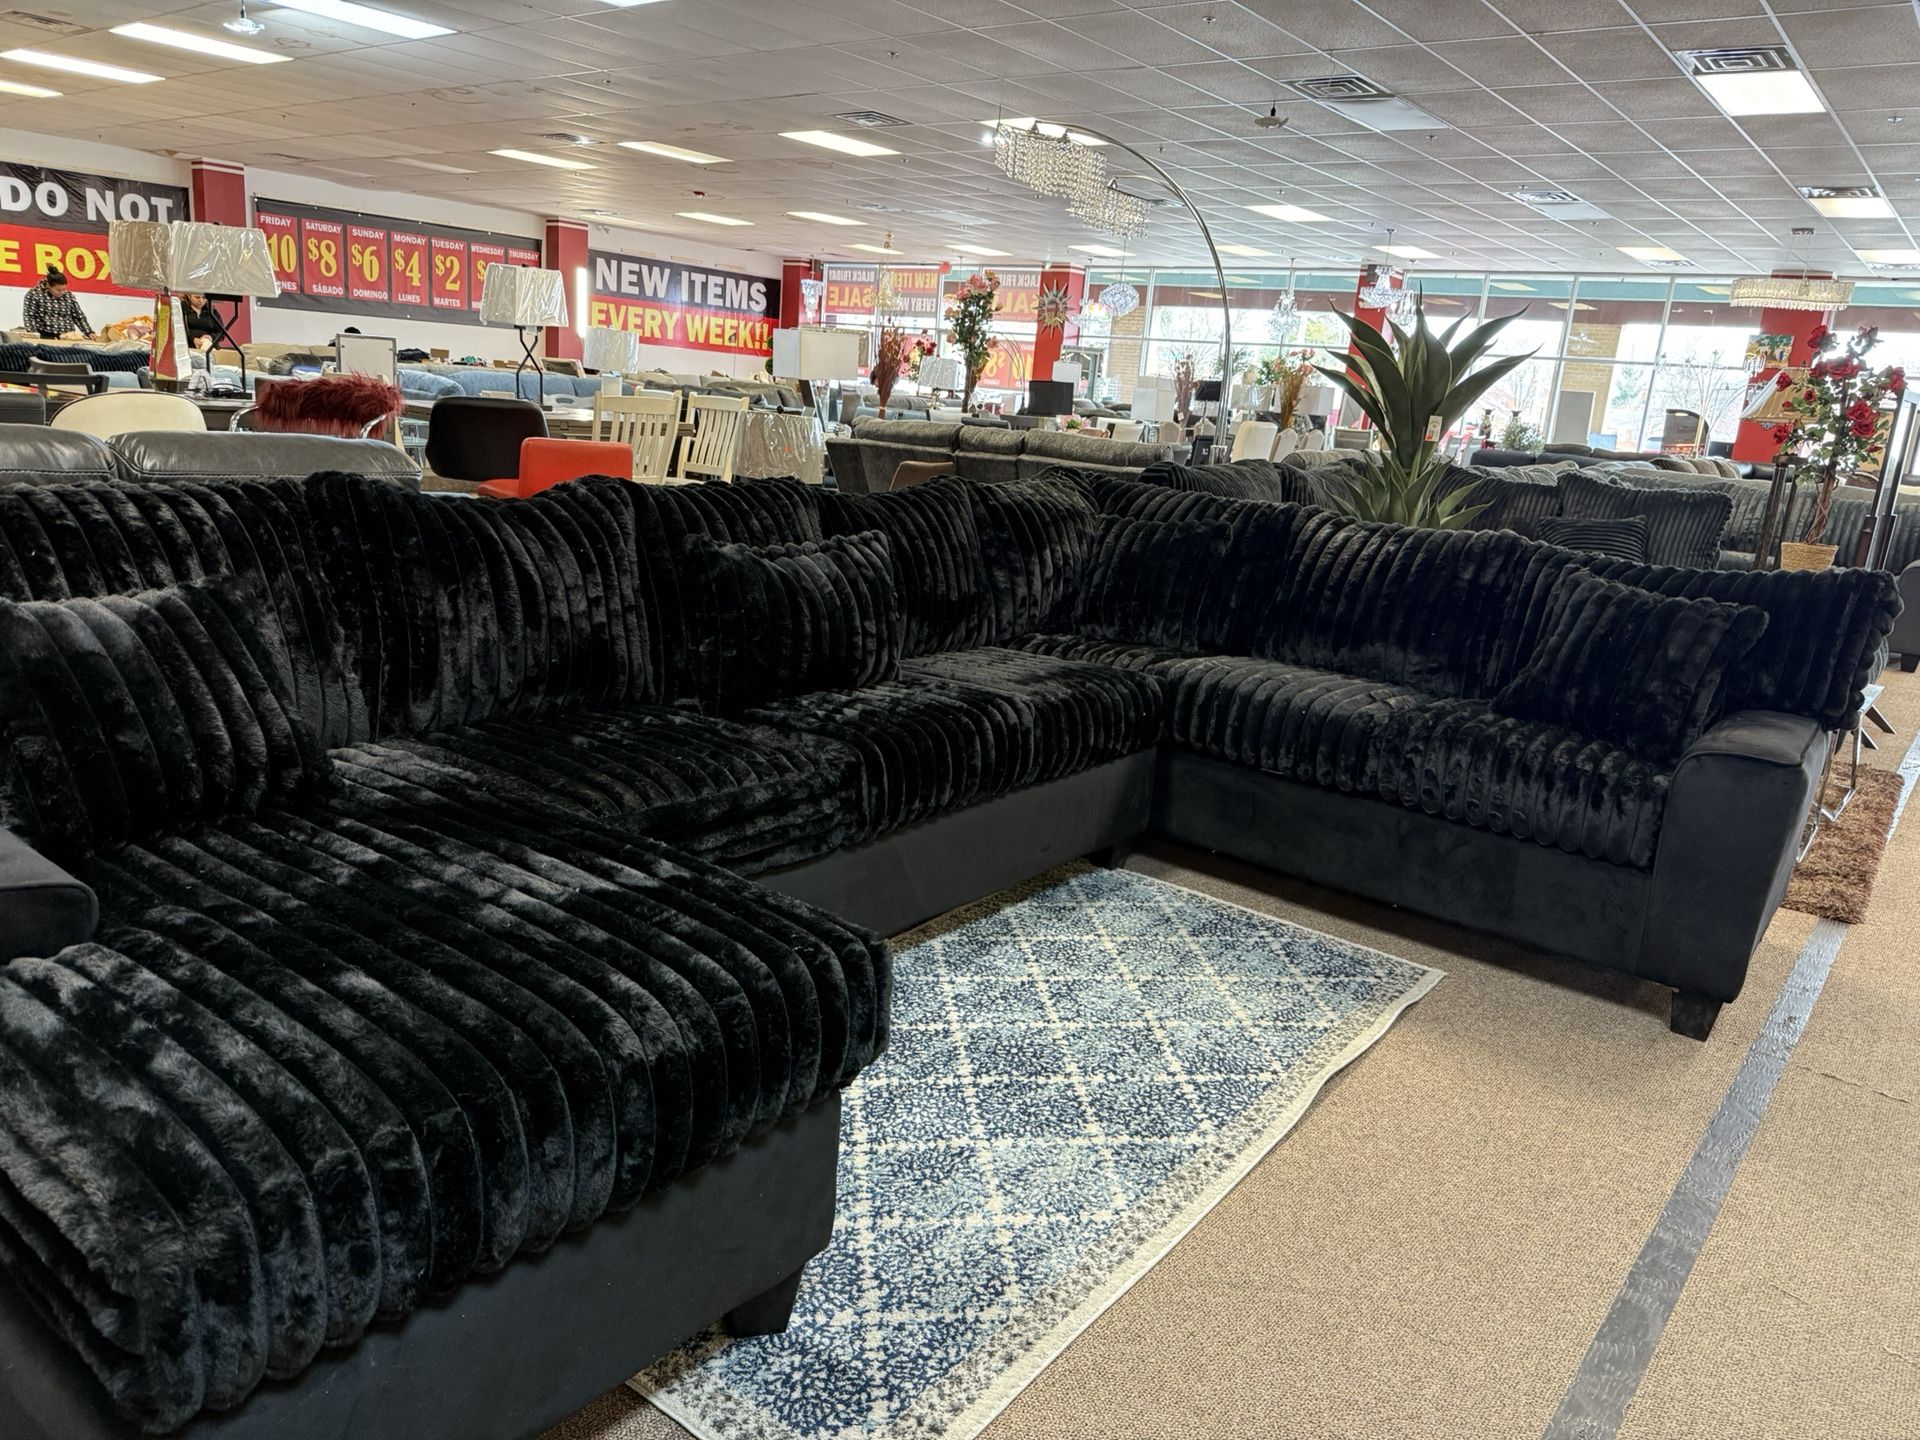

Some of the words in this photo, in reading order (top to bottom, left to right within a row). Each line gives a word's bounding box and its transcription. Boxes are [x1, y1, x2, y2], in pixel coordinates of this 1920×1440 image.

[0, 175, 69, 217] DO
[85, 187, 174, 225] NOT
[260, 215, 291, 227] FRIDAY
[305, 221, 342, 234] SATURDAY
[352, 228, 384, 239] SUNDAY
[394, 233, 426, 245] MONDAY
[431, 239, 464, 251] TUESDAY
[267, 232, 297, 273] 10
[307, 237, 337, 277] $8
[471, 245, 504, 257] WEDNESDAY
[509, 250, 539, 261] THURSDAY
[351, 243, 379, 282] $6
[394, 248, 421, 286] $4
[434, 254, 460, 291] $2
[312, 283, 343, 295] SÁBADO
[596, 257, 671, 299] NEW
[680, 270, 767, 312] ITEMS
[353, 288, 388, 300] DOMINGO
[398, 293, 420, 303] LUNES
[434, 297, 461, 307] MARTES
[592, 301, 680, 341] EVERY
[685, 313, 769, 350] WEEK!!
